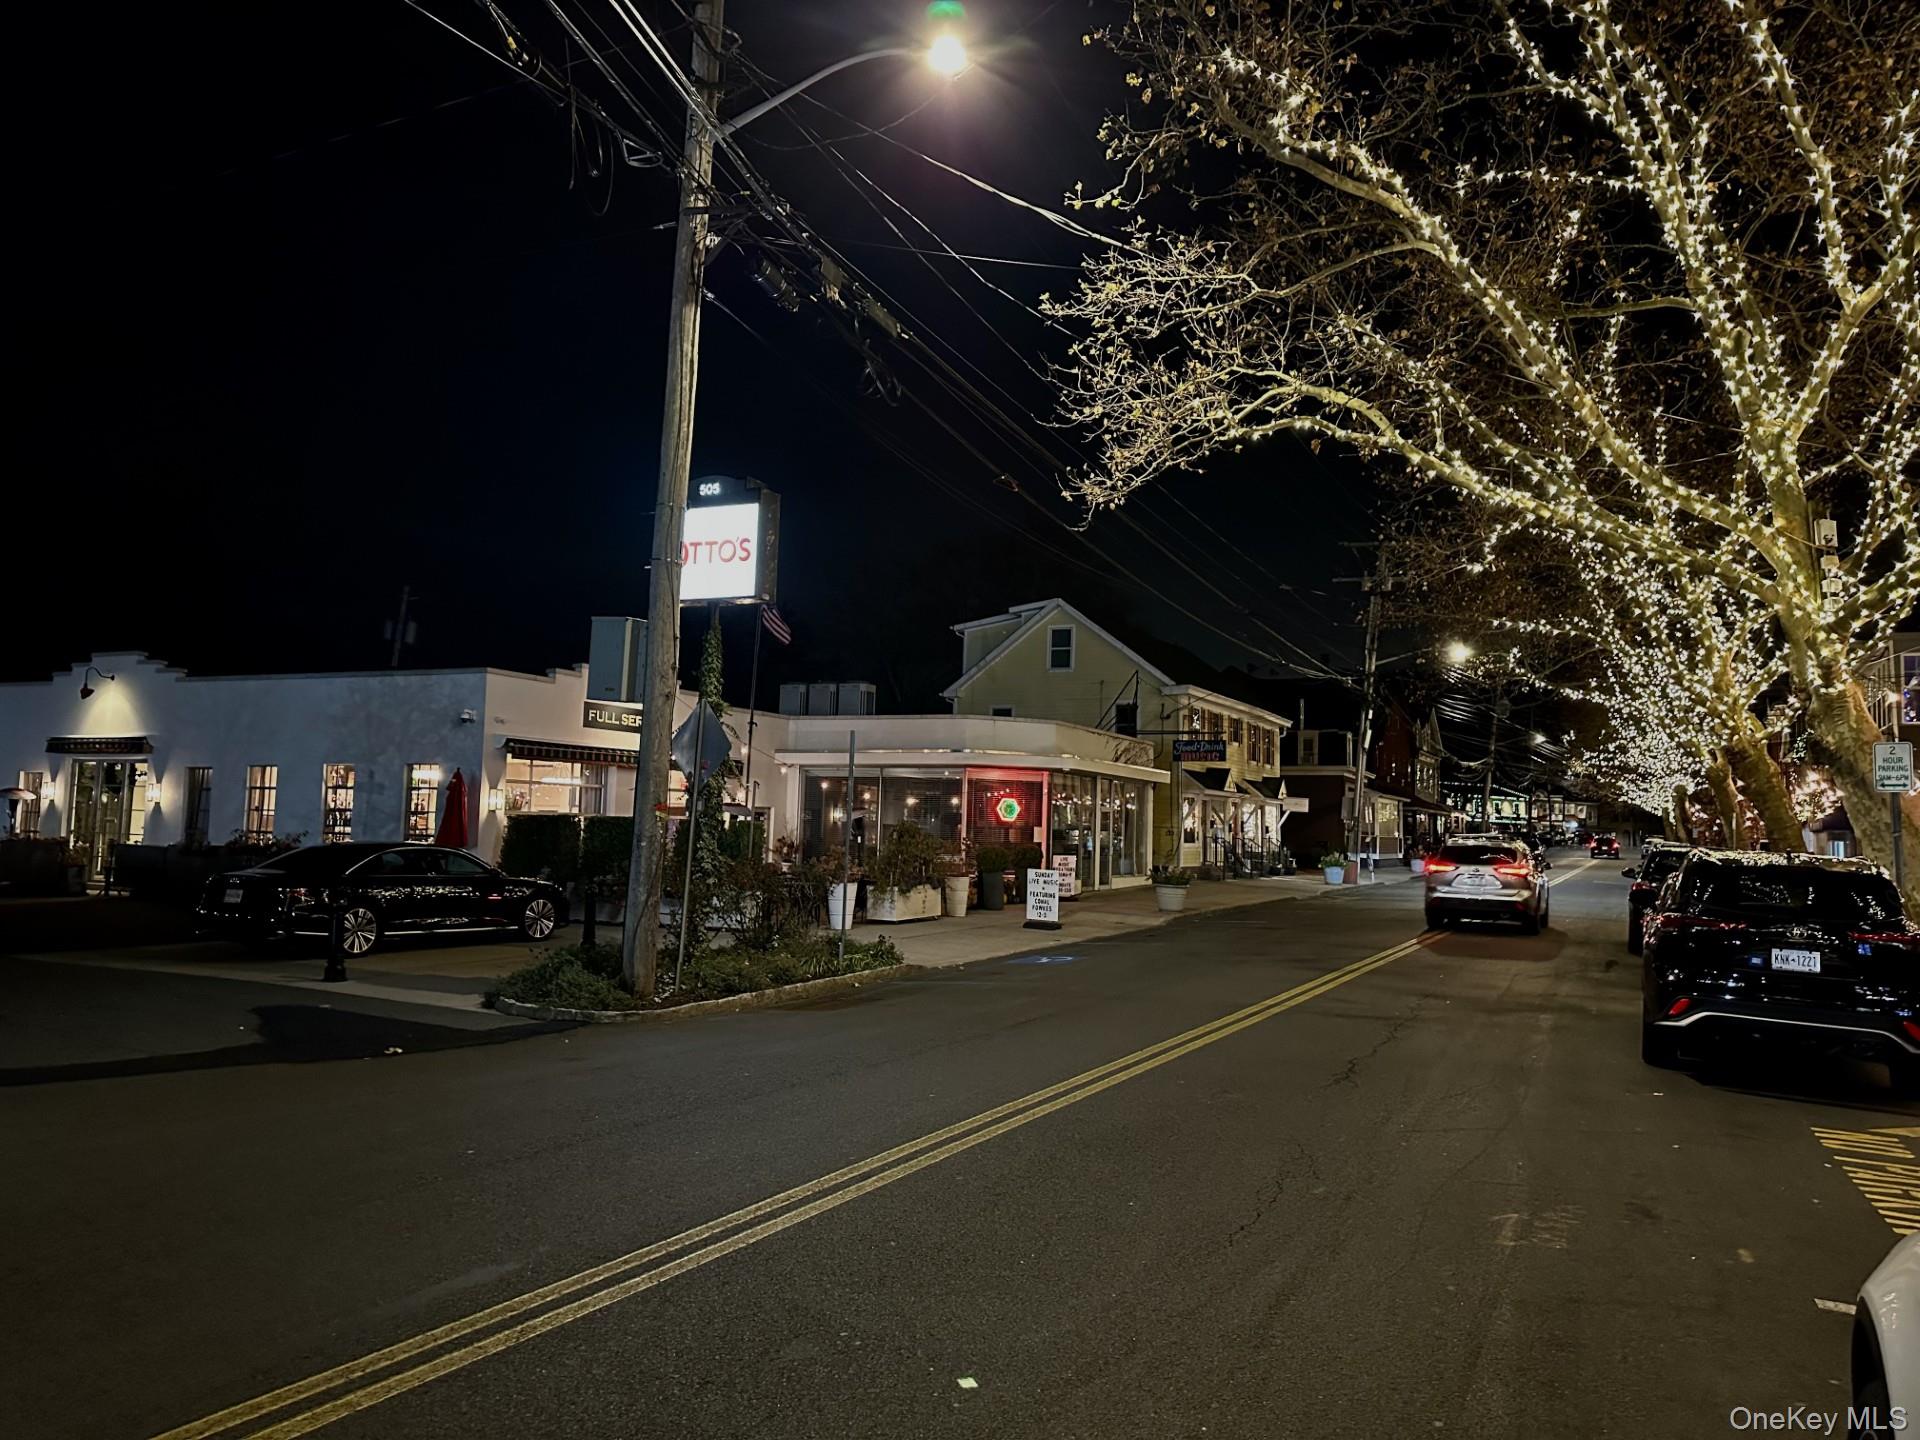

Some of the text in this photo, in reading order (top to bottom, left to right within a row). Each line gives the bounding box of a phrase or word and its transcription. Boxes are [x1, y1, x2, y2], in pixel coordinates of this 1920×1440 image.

[699, 482, 721, 496] 505
[588, 709, 620, 725] FULL
[1889, 746, 1896, 755] 2
